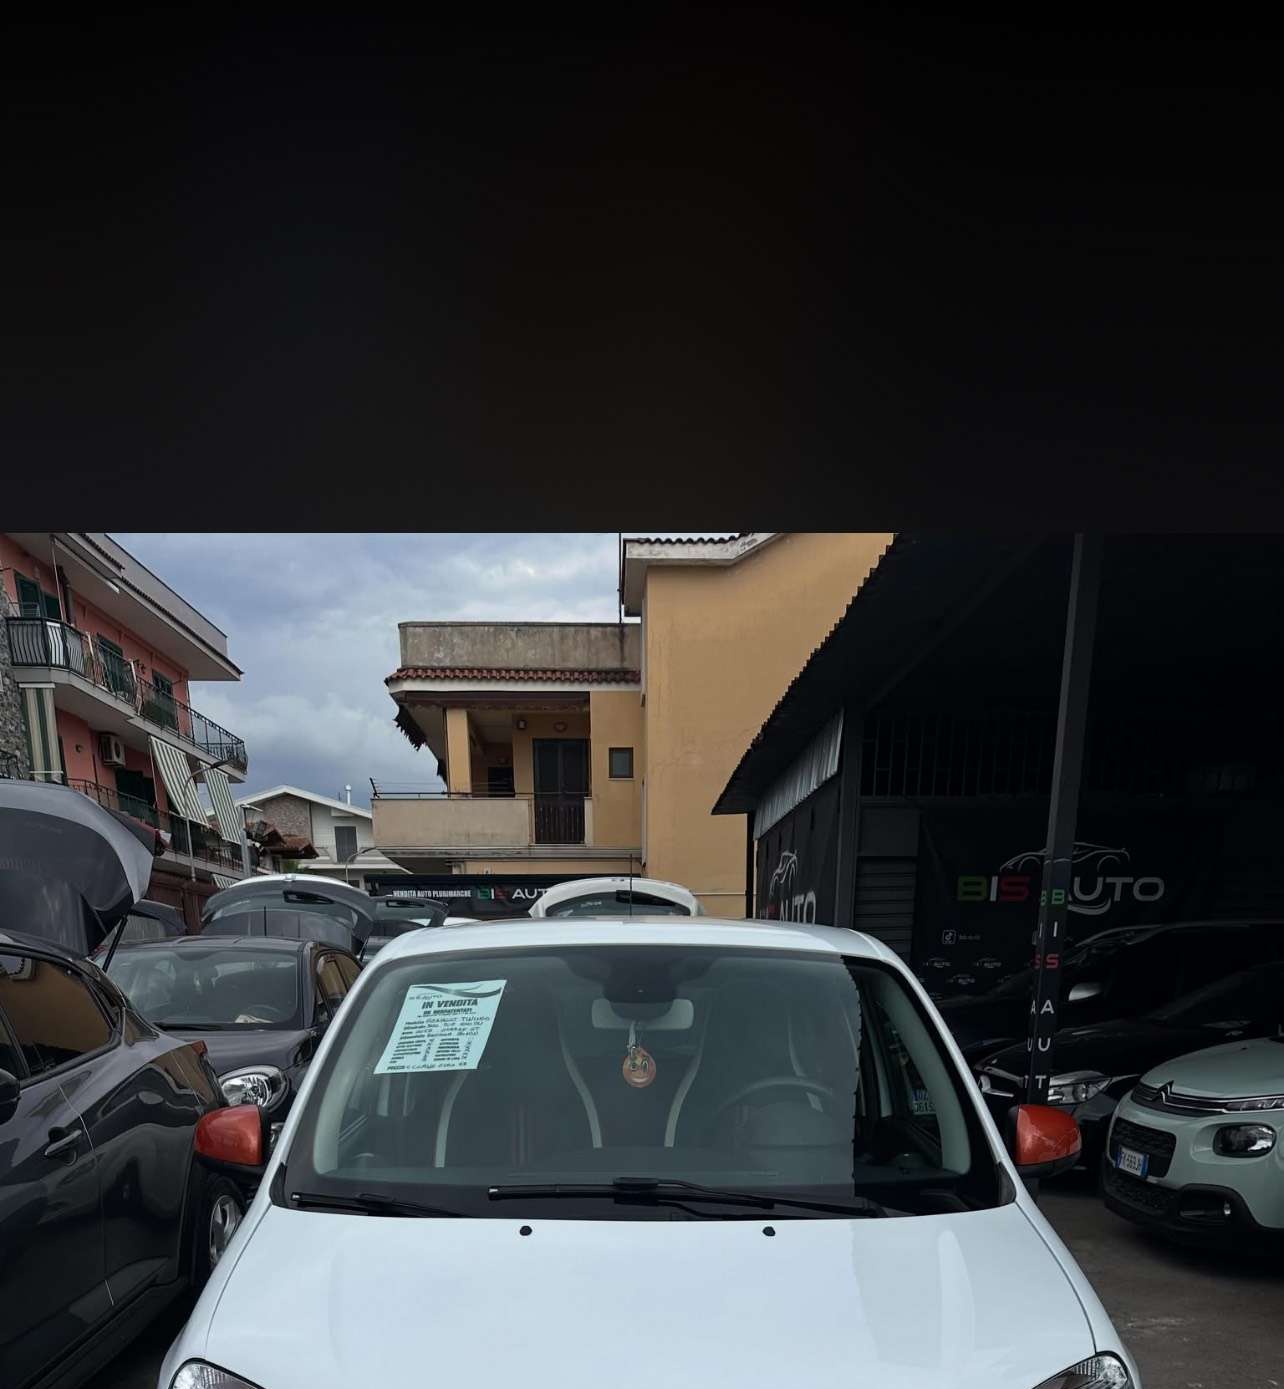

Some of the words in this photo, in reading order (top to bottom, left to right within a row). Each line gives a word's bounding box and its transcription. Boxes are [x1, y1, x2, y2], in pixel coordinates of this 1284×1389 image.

[512, 888, 549, 899] AUT
[957, 875, 1032, 902] BIS
[1069, 875, 1166, 902] UTO
[393, 890, 417, 898] VENDITA
[417, 890, 432, 898] AUTO
[432, 890, 472, 898] PLURIMARCHE
[421, 1001, 433, 1009] IN
[437, 999, 478, 1008] VENDITA
